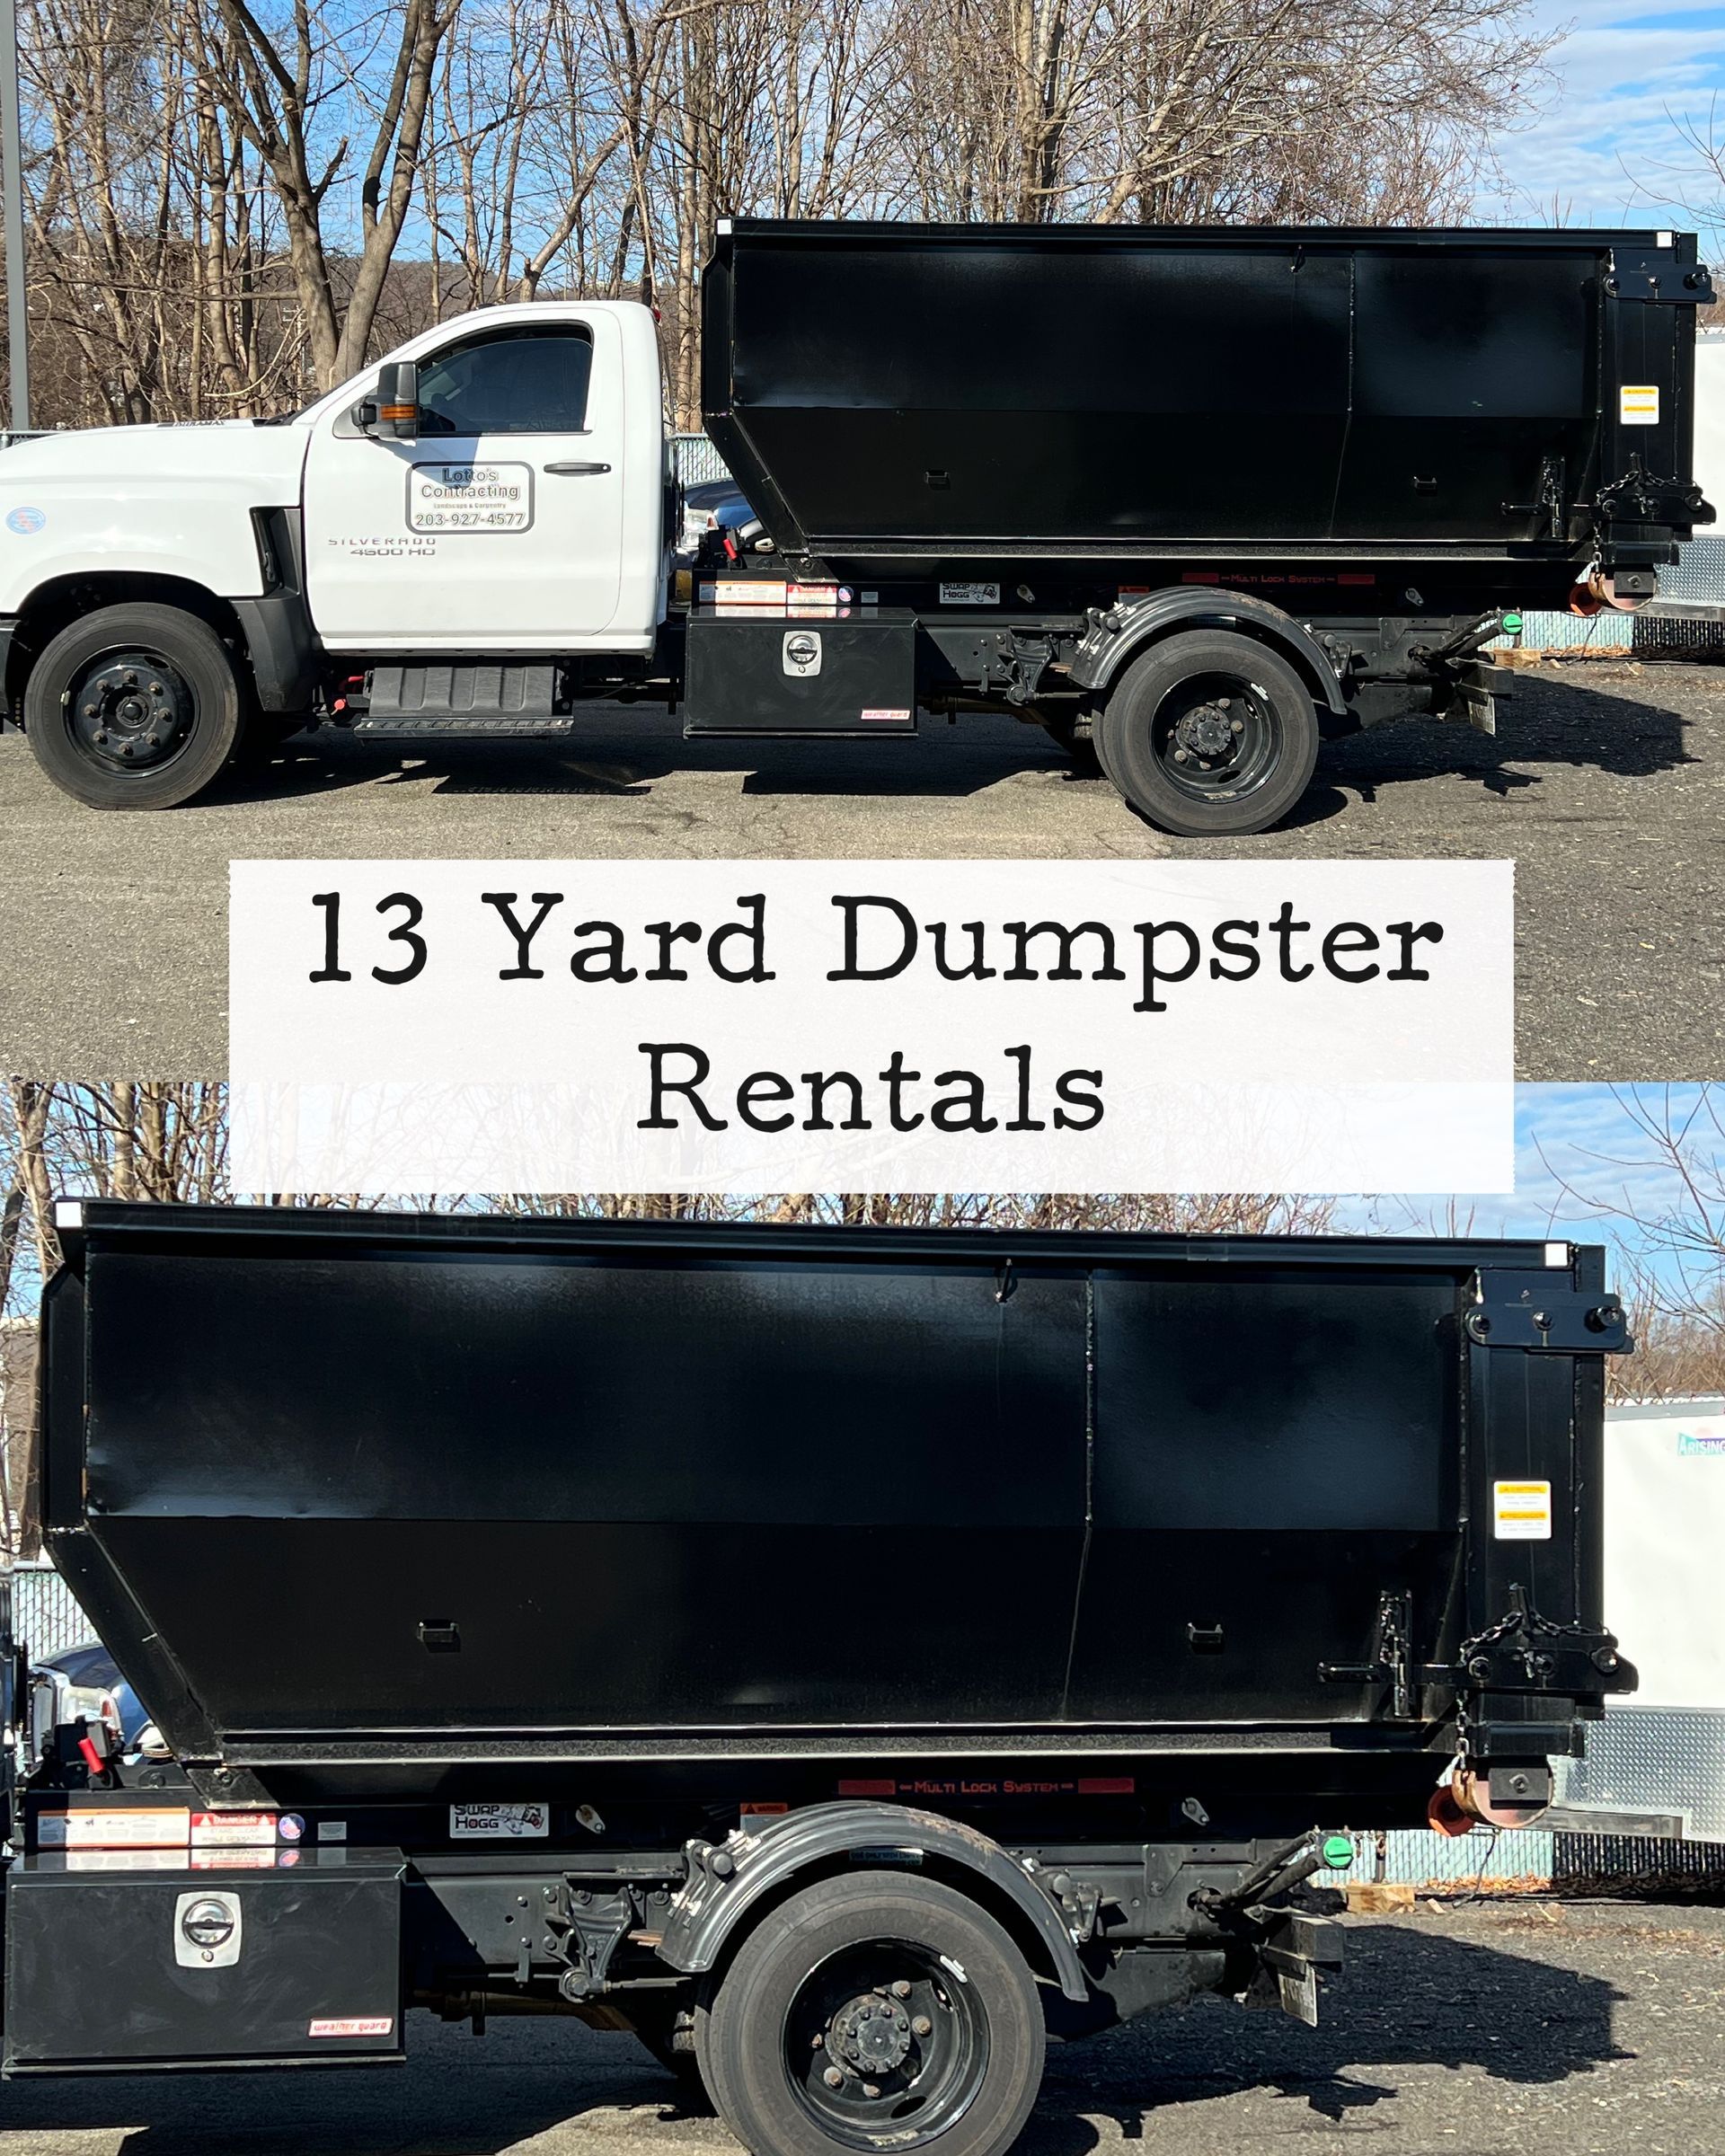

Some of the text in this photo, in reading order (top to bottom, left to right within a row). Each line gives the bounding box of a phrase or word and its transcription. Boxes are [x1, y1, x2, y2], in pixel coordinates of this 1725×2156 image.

[441, 467, 499, 483] Lotto's
[421, 484, 520, 500] Contracting
[416, 513, 526, 526] 203-927-4577
